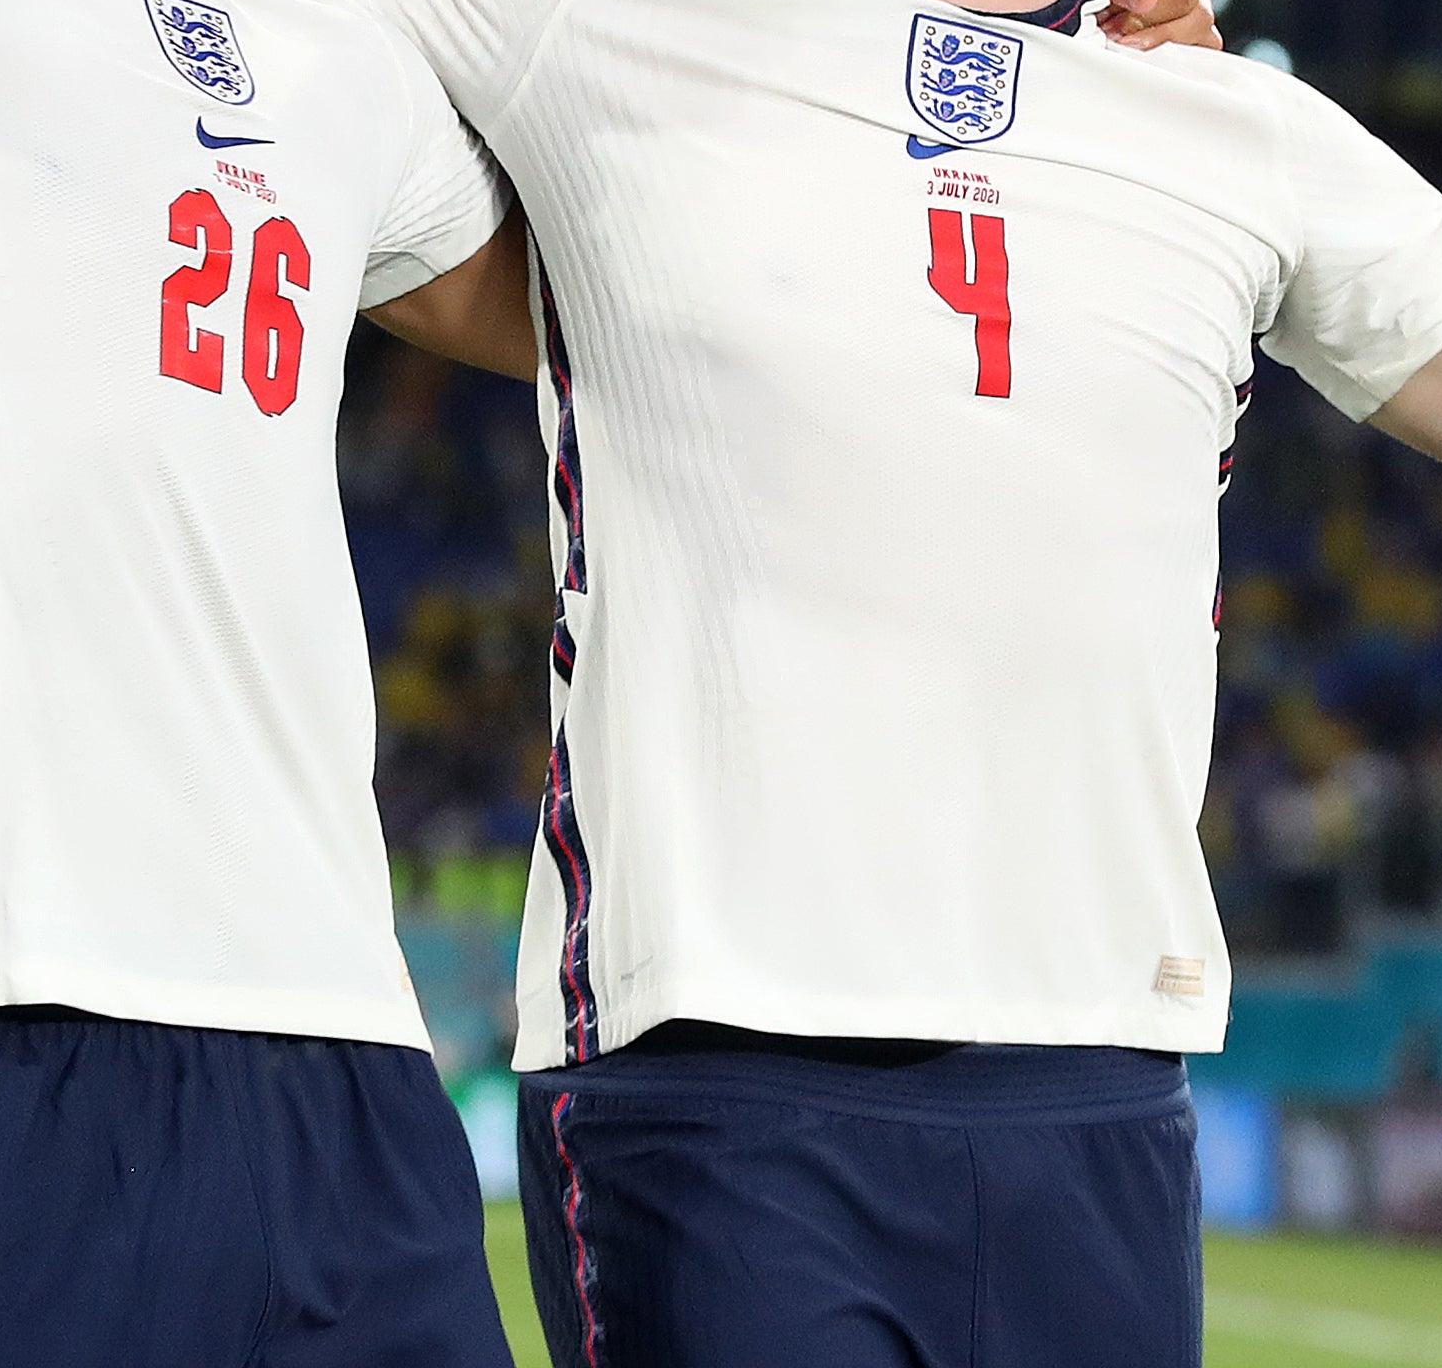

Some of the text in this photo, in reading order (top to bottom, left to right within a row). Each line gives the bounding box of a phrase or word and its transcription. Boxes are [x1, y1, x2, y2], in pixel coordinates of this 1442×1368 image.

[927, 180, 1000, 205] 3 JULY 2021
[933, 167, 992, 186] UKRAINE
[159, 187, 311, 417] 26
[927, 207, 1012, 399] 4
